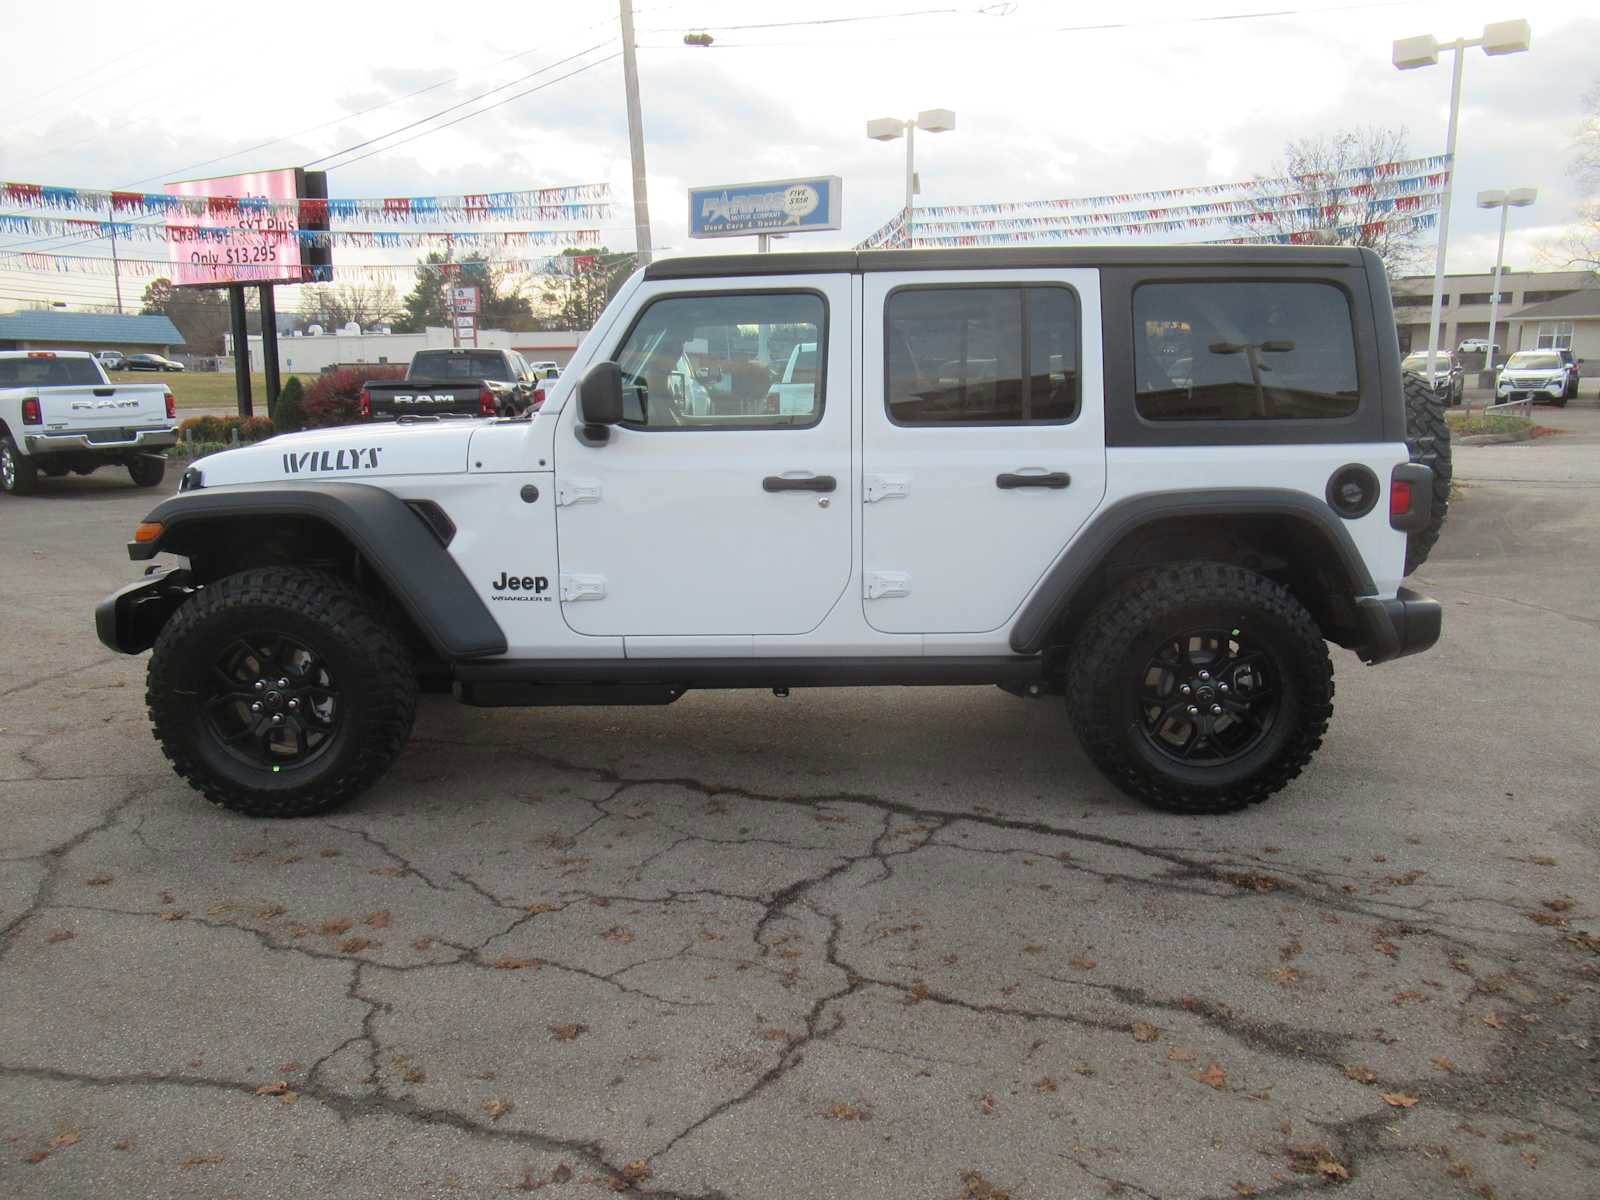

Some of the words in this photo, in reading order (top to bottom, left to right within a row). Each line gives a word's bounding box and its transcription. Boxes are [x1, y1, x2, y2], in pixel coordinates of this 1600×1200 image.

[790, 189, 807, 197] FIVE
[789, 196, 808, 205] STAR
[267, 217, 294, 234] Plus
[726, 222, 744, 231] Cars
[191, 250, 219, 270] Only
[226, 244, 276, 264] $13,295
[71, 399, 139, 410] RAM
[394, 395, 455, 404] RAM
[283, 447, 383, 473] WILLYS
[492, 572, 549, 593] Jeep
